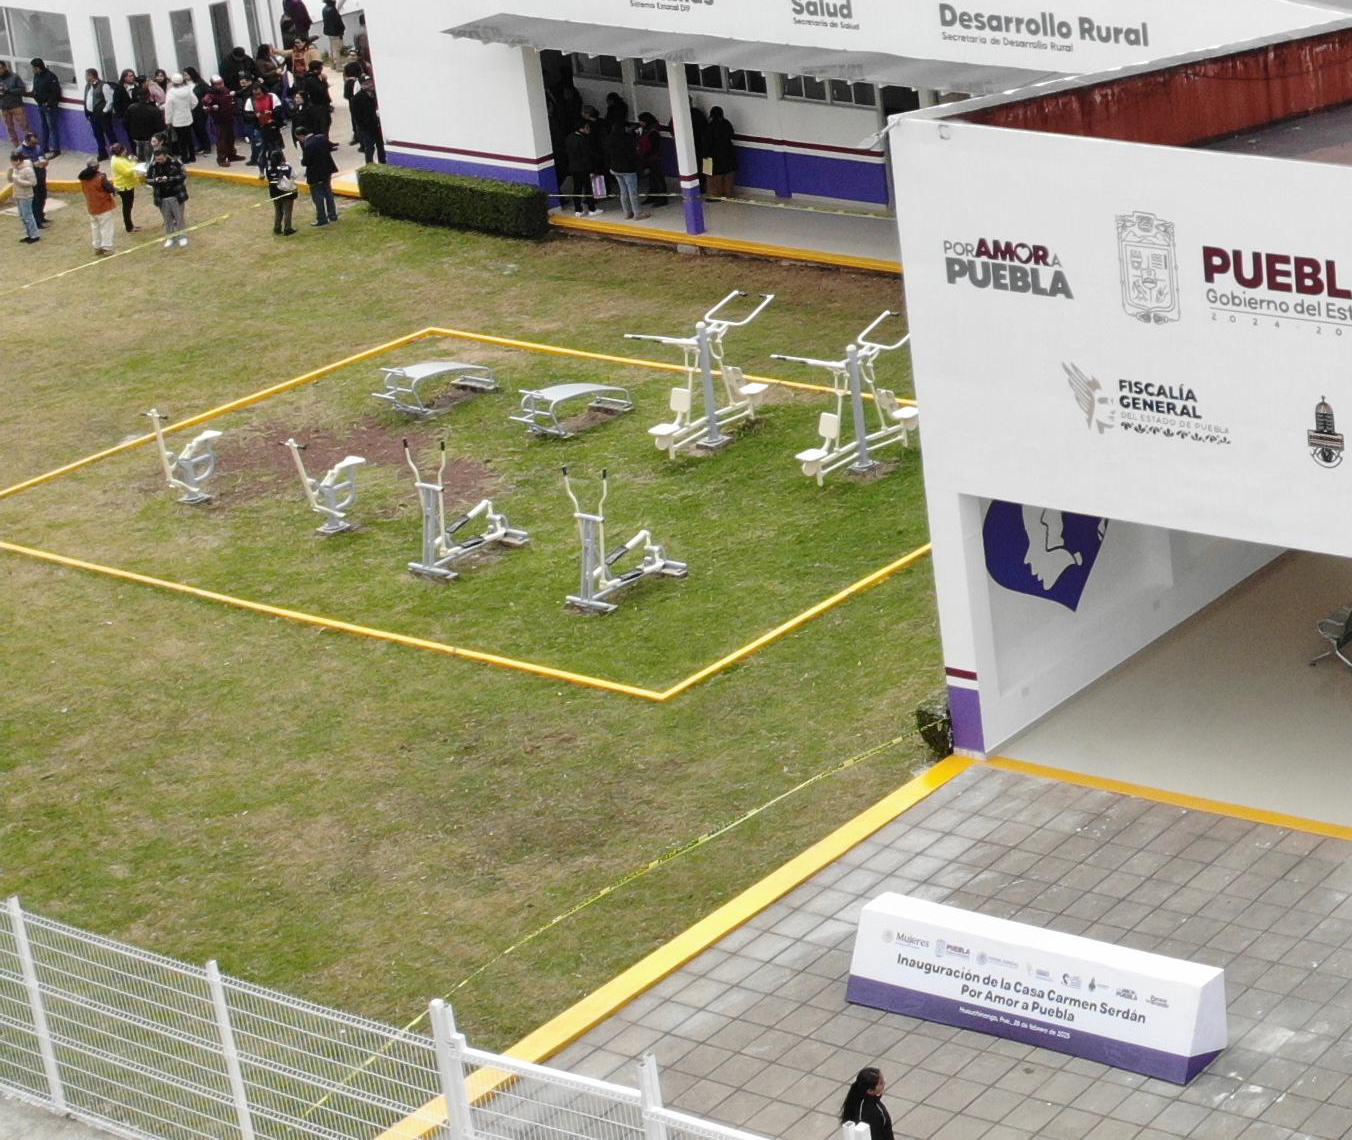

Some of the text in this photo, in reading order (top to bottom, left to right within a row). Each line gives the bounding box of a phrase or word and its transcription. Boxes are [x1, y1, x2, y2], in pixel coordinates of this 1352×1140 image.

[939, 3, 1150, 47] Desarrollo Rural
[990, 36, 1001, 46] de
[1003, 37, 1049, 50] Desarrollo
[1050, 41, 1074, 53] Rural
[943, 237, 1064, 269] POR AMOR A
[945, 256, 1075, 300] PUEBLA
[1205, 287, 1290, 314] Gobierno
[1293, 298, 1322, 317] del
[1118, 378, 1198, 403] FISCALÍA
[1119, 394, 1203, 420] GENERAL
[897, 953, 980, 983] Inauguración
[982, 974, 998, 988] de
[1000, 977, 1011, 991] la
[1013, 981, 1045, 999] Casa
[1047, 989, 1098, 1012] Carmen
[1099, 1001, 1146, 1023] Serdán
[961, 984, 1075, 1022] Por Amor a Puebla
